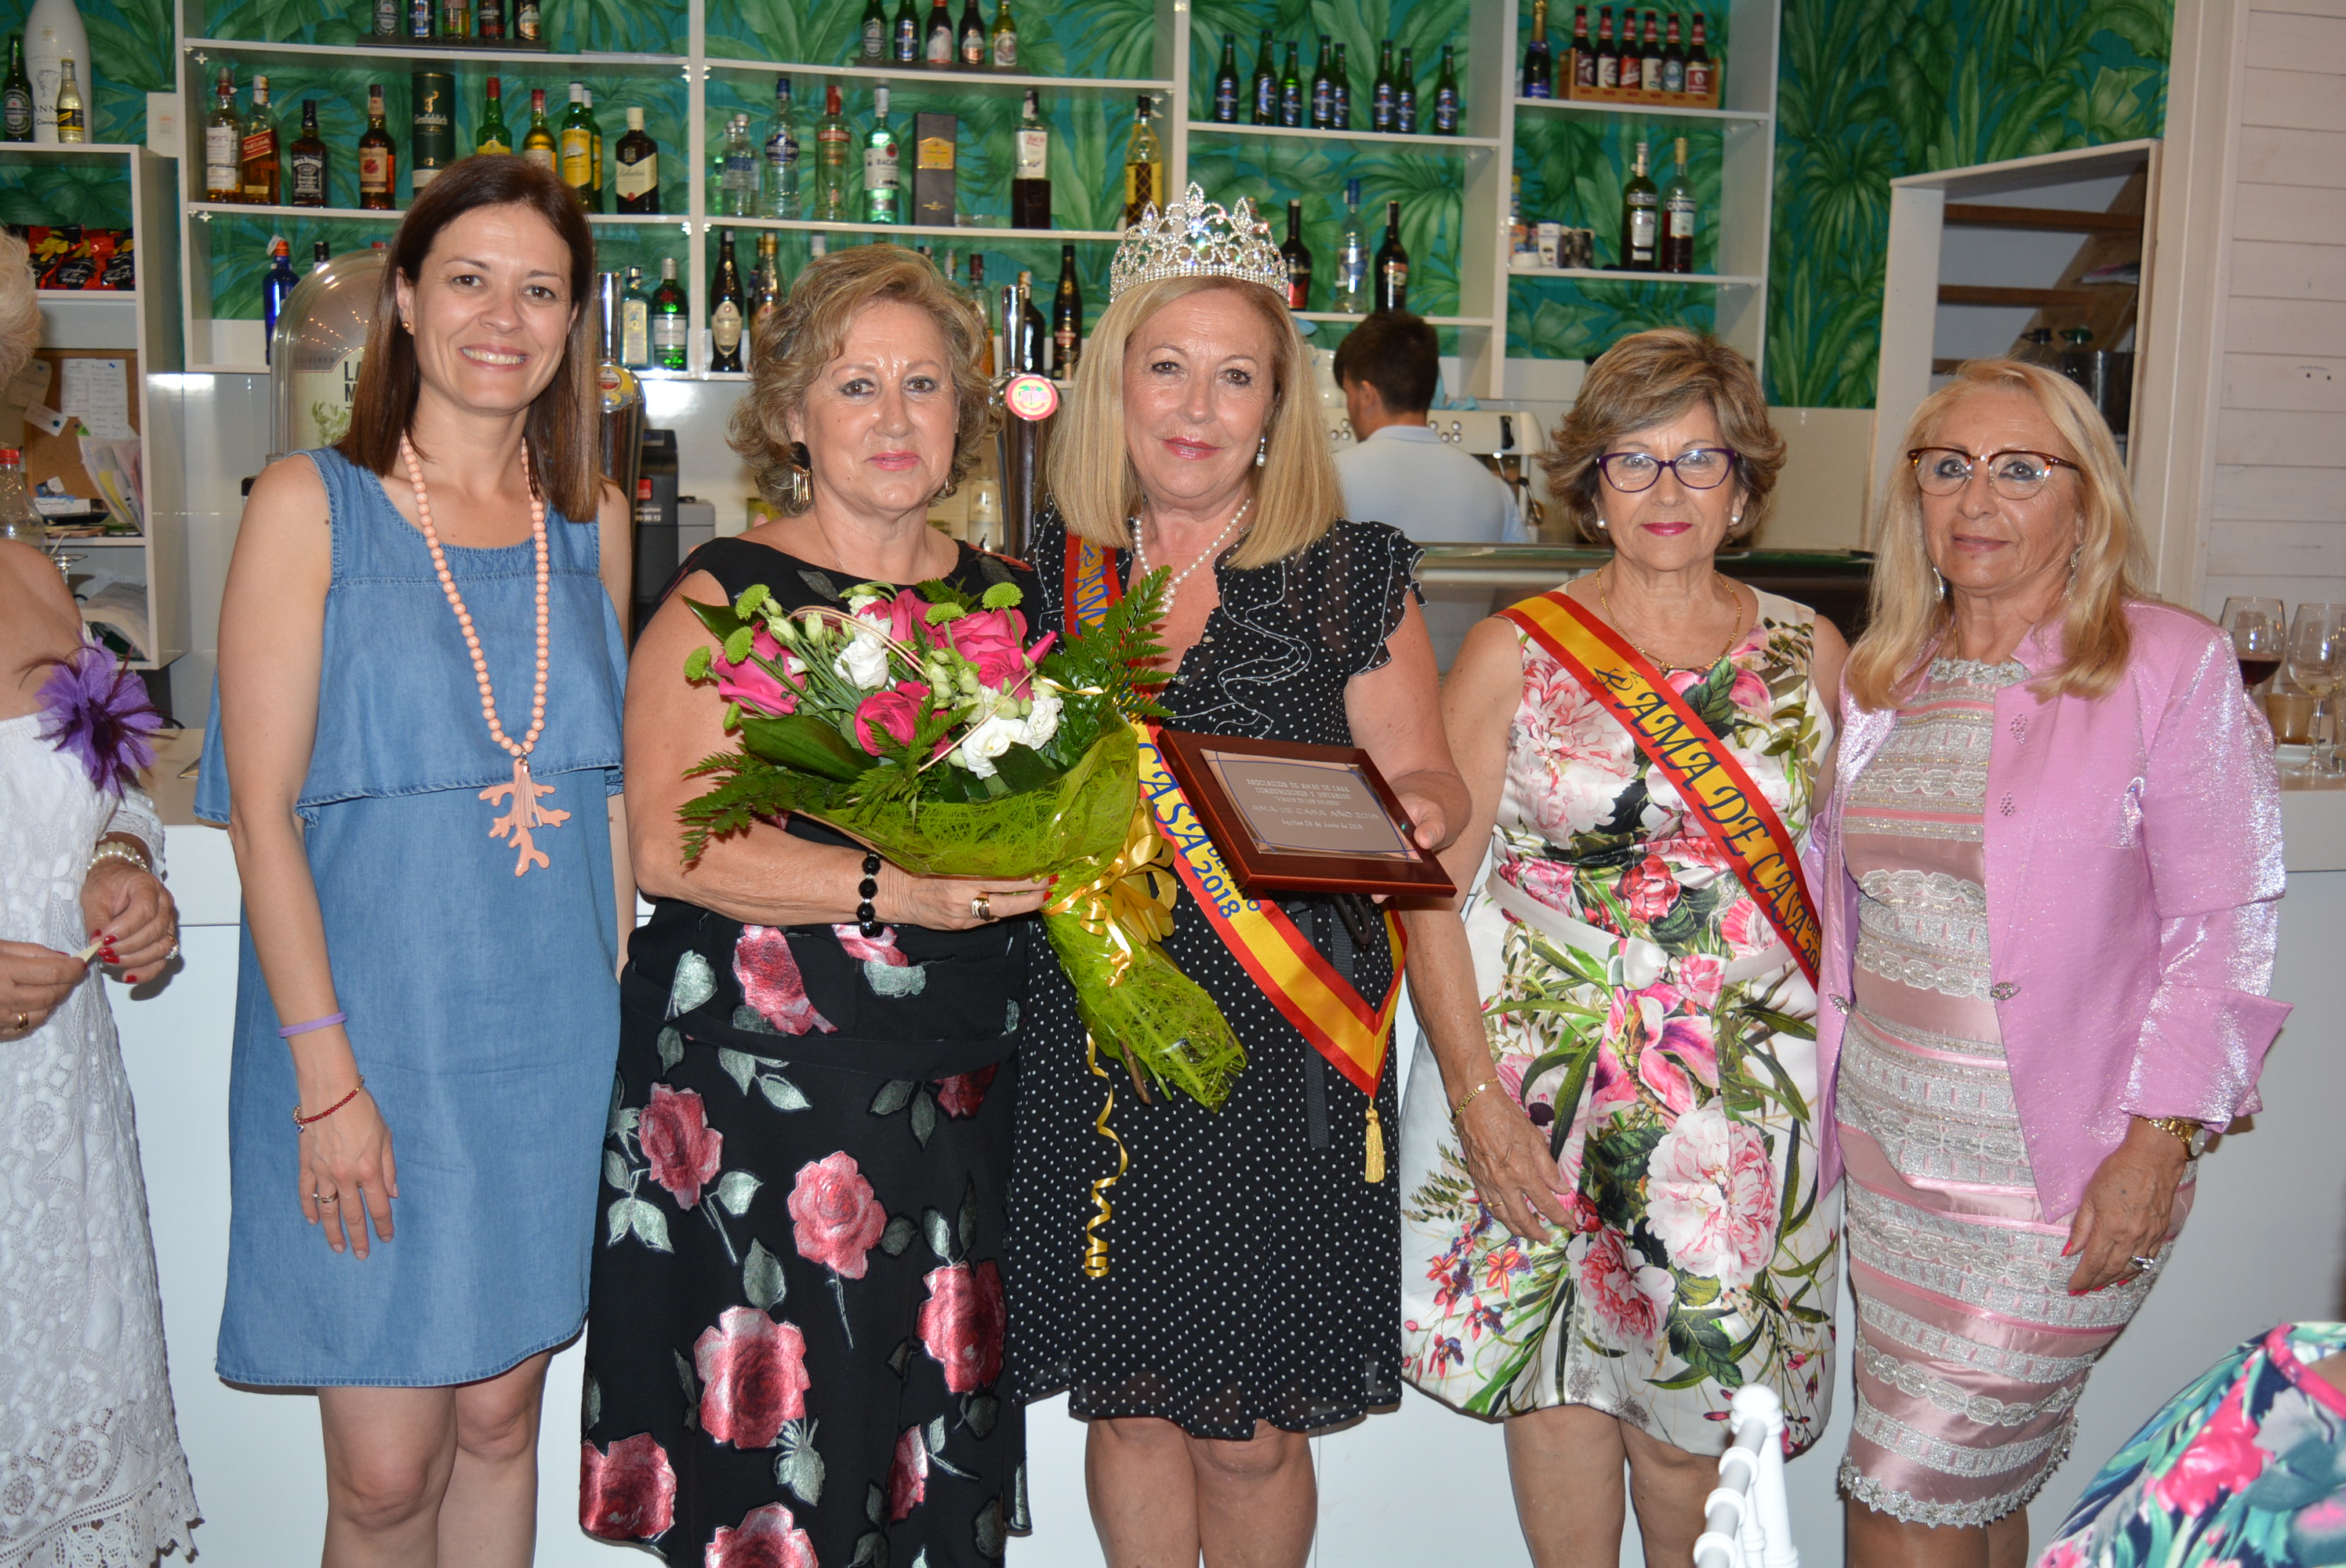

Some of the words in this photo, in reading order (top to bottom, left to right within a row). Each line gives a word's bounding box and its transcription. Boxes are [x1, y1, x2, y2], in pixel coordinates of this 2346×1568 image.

[1138, 742, 1215, 860] CASA
[1251, 804, 1278, 813] AMA
[1296, 808, 1327, 816] CASA
[1255, 787, 1309, 797] CONSUMIDORES
[1614, 691, 1722, 792] AMA
[1699, 786, 1770, 857] DE
[1746, 852, 1810, 947] CASA
[1190, 860, 1241, 919] 2018
